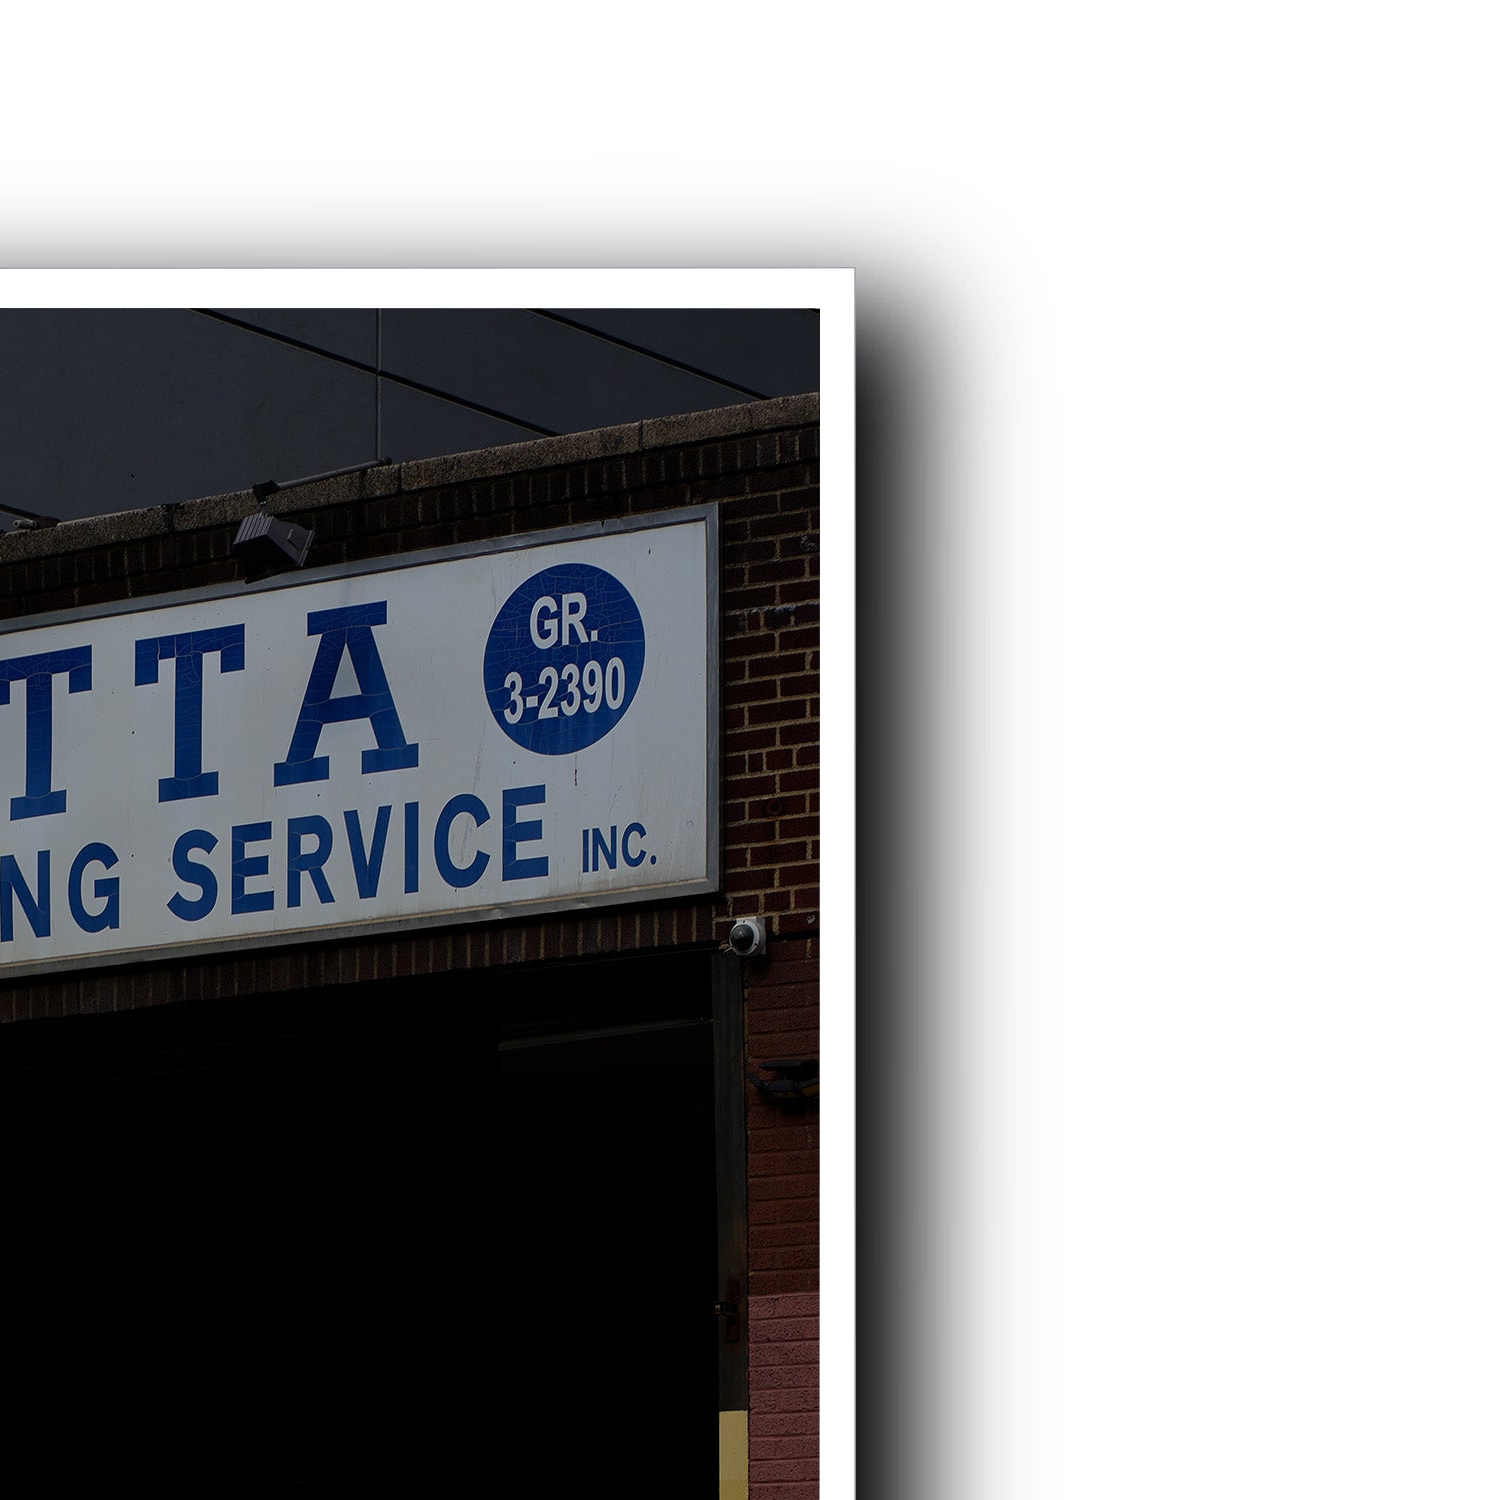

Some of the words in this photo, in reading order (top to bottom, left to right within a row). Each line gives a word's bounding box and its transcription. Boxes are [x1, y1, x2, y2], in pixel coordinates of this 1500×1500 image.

[529, 592, 598, 649] GR.
[503, 657, 626, 724] 3-2390
[167, 784, 549, 921] SERVICE
[582, 823, 657, 873] INC.
